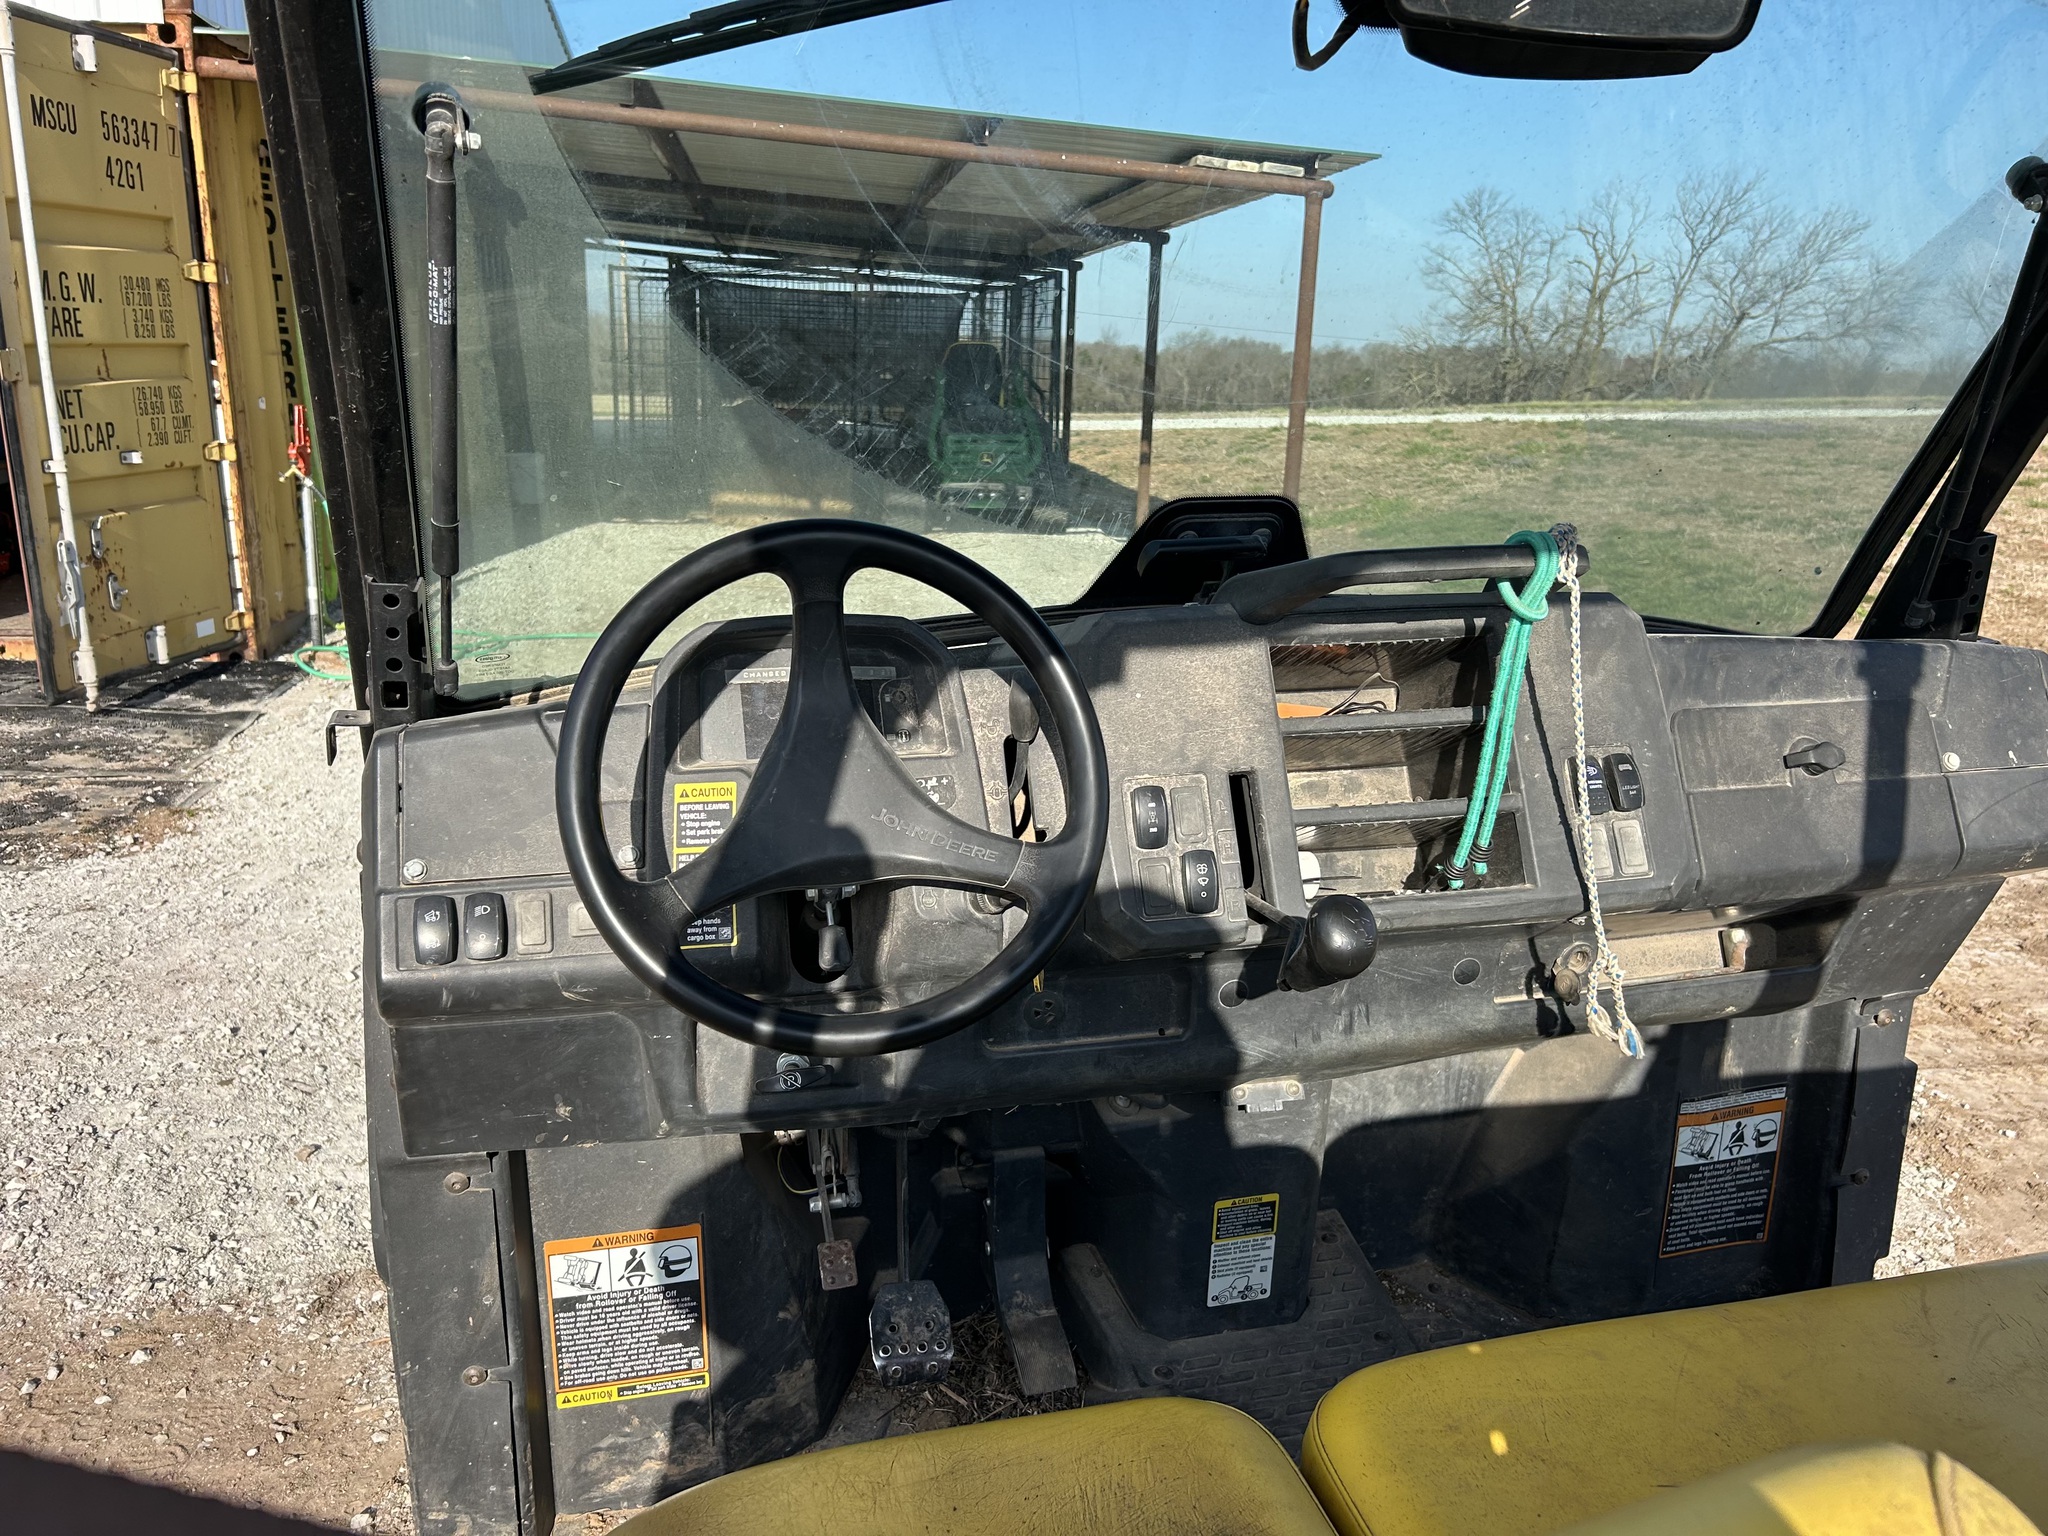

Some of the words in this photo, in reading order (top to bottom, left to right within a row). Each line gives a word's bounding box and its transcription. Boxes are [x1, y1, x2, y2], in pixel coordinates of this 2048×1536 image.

[30, 94, 77, 135] MSCU
[101, 110, 158, 151] 563347
[167, 126, 177, 155] 7
[105, 155, 144, 191] 42G1
[123, 275, 150, 291] 30.480
[126, 292, 152, 306] 67.200
[158, 293, 172, 308] LBS
[45, 306, 83, 337] ARE
[132, 308, 154, 324] 3.740
[160, 309, 174, 324] KGS
[134, 324, 156, 338] 8.250
[161, 325, 175, 338] LBS
[136, 386, 163, 400] 26.740
[168, 386, 182, 399] KGS
[56, 389, 82, 420] NET
[138, 401, 166, 416] 58.950
[170, 400, 184, 414] LBS
[150, 417, 166, 432] 67.7
[148, 432, 168, 447] 2.390
[691, 787, 732, 798] CAUTION
[871, 808, 928, 841] JOHN
[930, 830, 1000, 863] DEERE
[1720, 1106, 1754, 1118] WARNING
[605, 1232, 654, 1246] WARNING
[586, 1292, 608, 1301] Avoid
[610, 1289, 631, 1299] Injury
[643, 1285, 665, 1293] Death
[595, 1297, 626, 1306] Rollover
[638, 1292, 663, 1302] Falling
[573, 1390, 612, 1403] CAUTION
